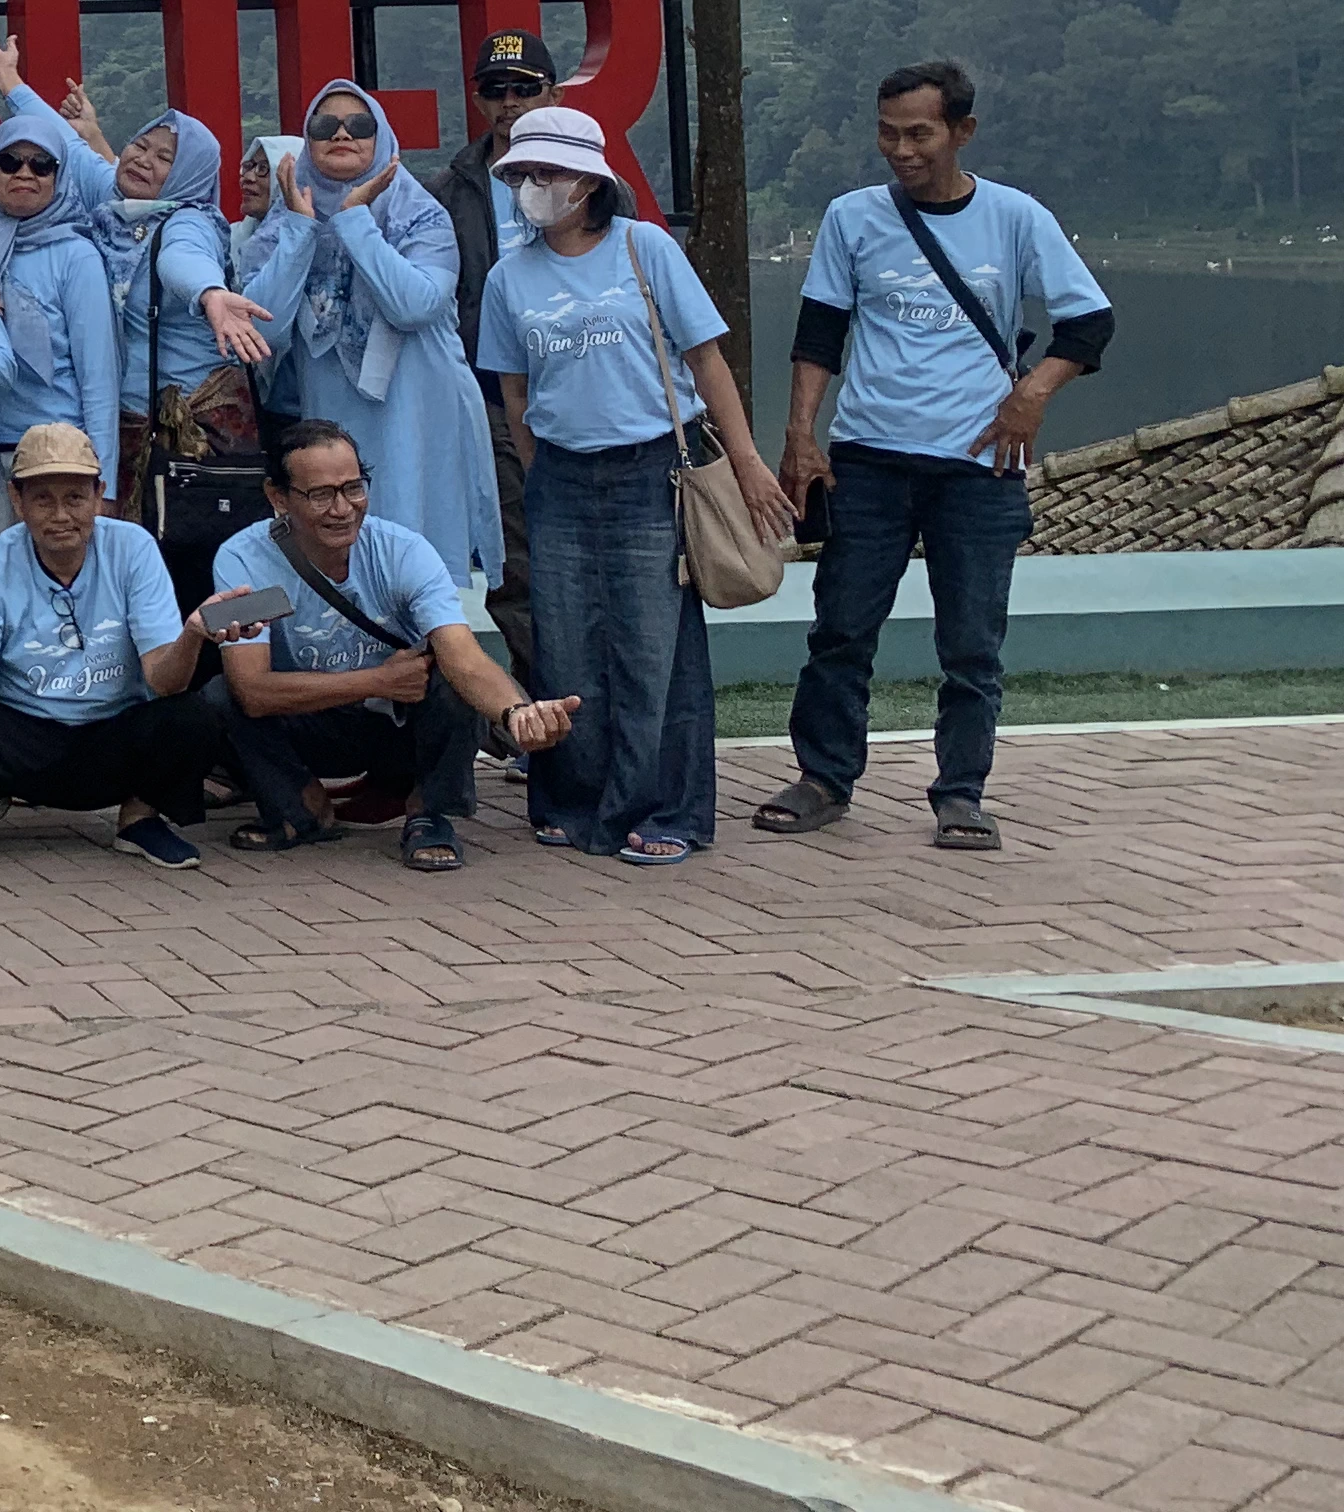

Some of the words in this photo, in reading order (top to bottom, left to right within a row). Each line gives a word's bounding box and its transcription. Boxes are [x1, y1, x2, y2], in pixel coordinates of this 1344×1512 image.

[492, 35, 523, 46] TURN
[489, 53, 523, 63] CRIME
[886, 290, 939, 323] Van
[526, 322, 575, 359] Van
[574, 328, 625, 359] Java
[27, 659, 73, 696] Van
[75, 665, 126, 697] Java
